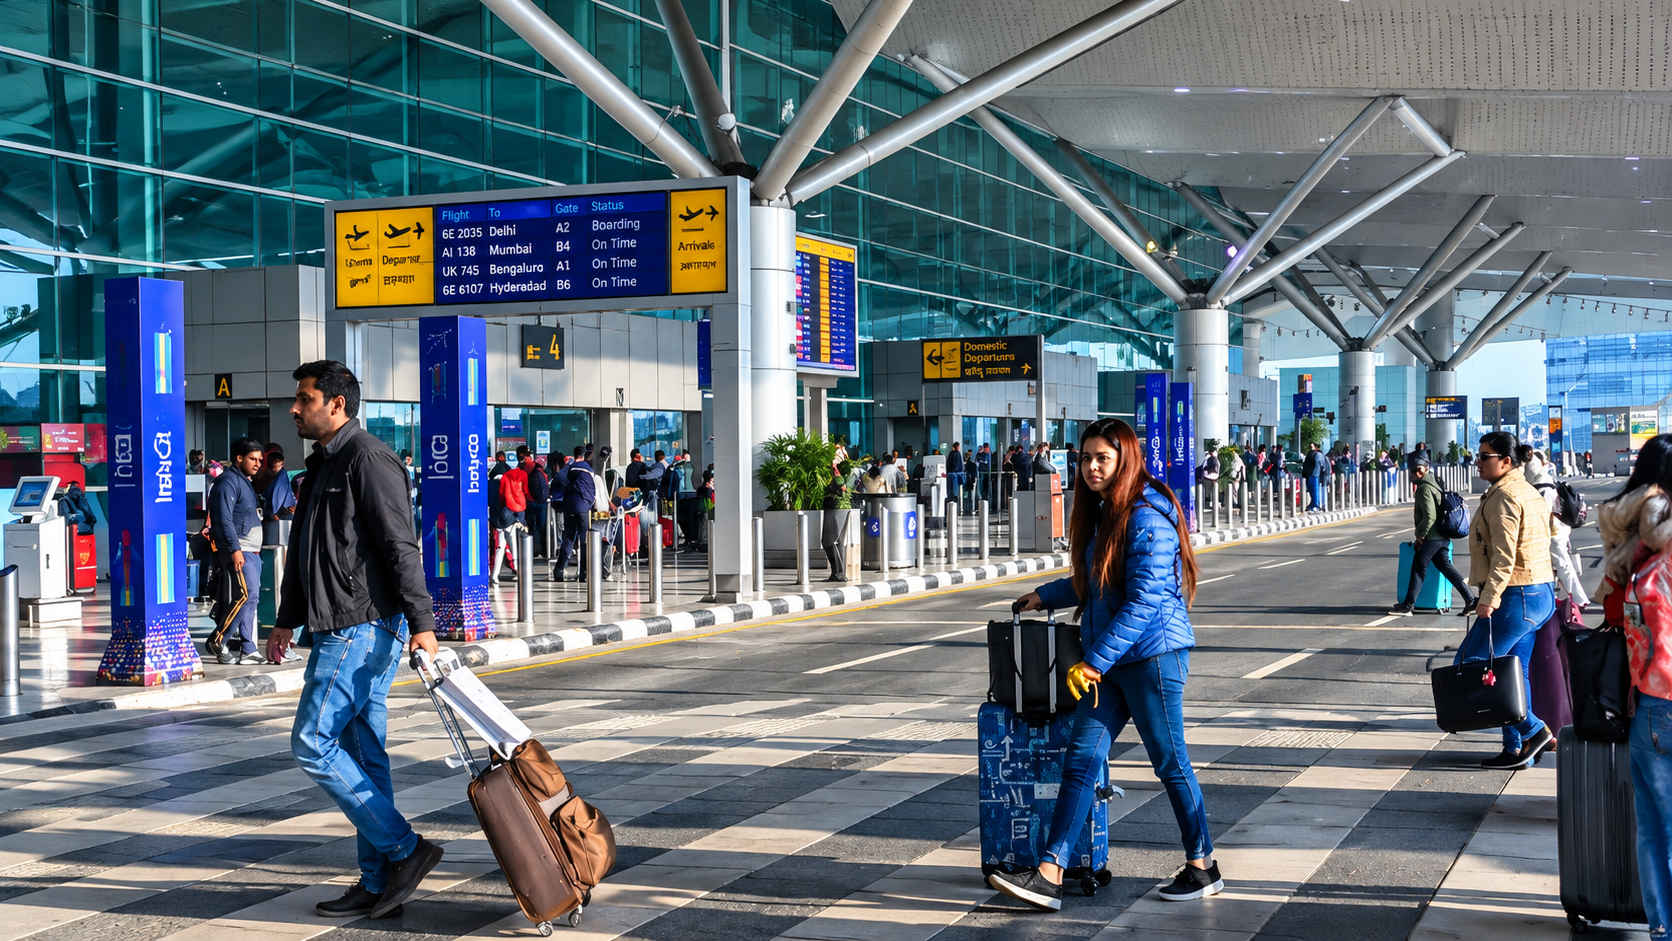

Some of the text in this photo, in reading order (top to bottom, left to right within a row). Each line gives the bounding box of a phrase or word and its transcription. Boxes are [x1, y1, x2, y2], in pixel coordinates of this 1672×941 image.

[488, 207, 501, 218] To
[555, 203, 579, 214] Gate
[591, 201, 624, 212] Status
[442, 210, 470, 223] Flight
[489, 224, 516, 237] Delhi
[555, 221, 570, 233] A2
[592, 218, 640, 231] Boarding
[442, 227, 483, 239] 6E 2035
[489, 242, 532, 256] Mumbai
[556, 240, 571, 252] B4
[591, 237, 637, 250] On Time
[442, 245, 476, 258] AI 138
[556, 260, 571, 271] A1
[591, 256, 637, 269] On Time
[442, 265, 480, 277] UK 745
[489, 262, 544, 277] Bengaluro
[556, 279, 571, 290] B6
[591, 276, 637, 288] On Time
[442, 283, 484, 296] 6E 6107
[549, 334, 560, 360] 4
[964, 340, 1008, 352] Domestic
[217, 377, 230, 397] A
